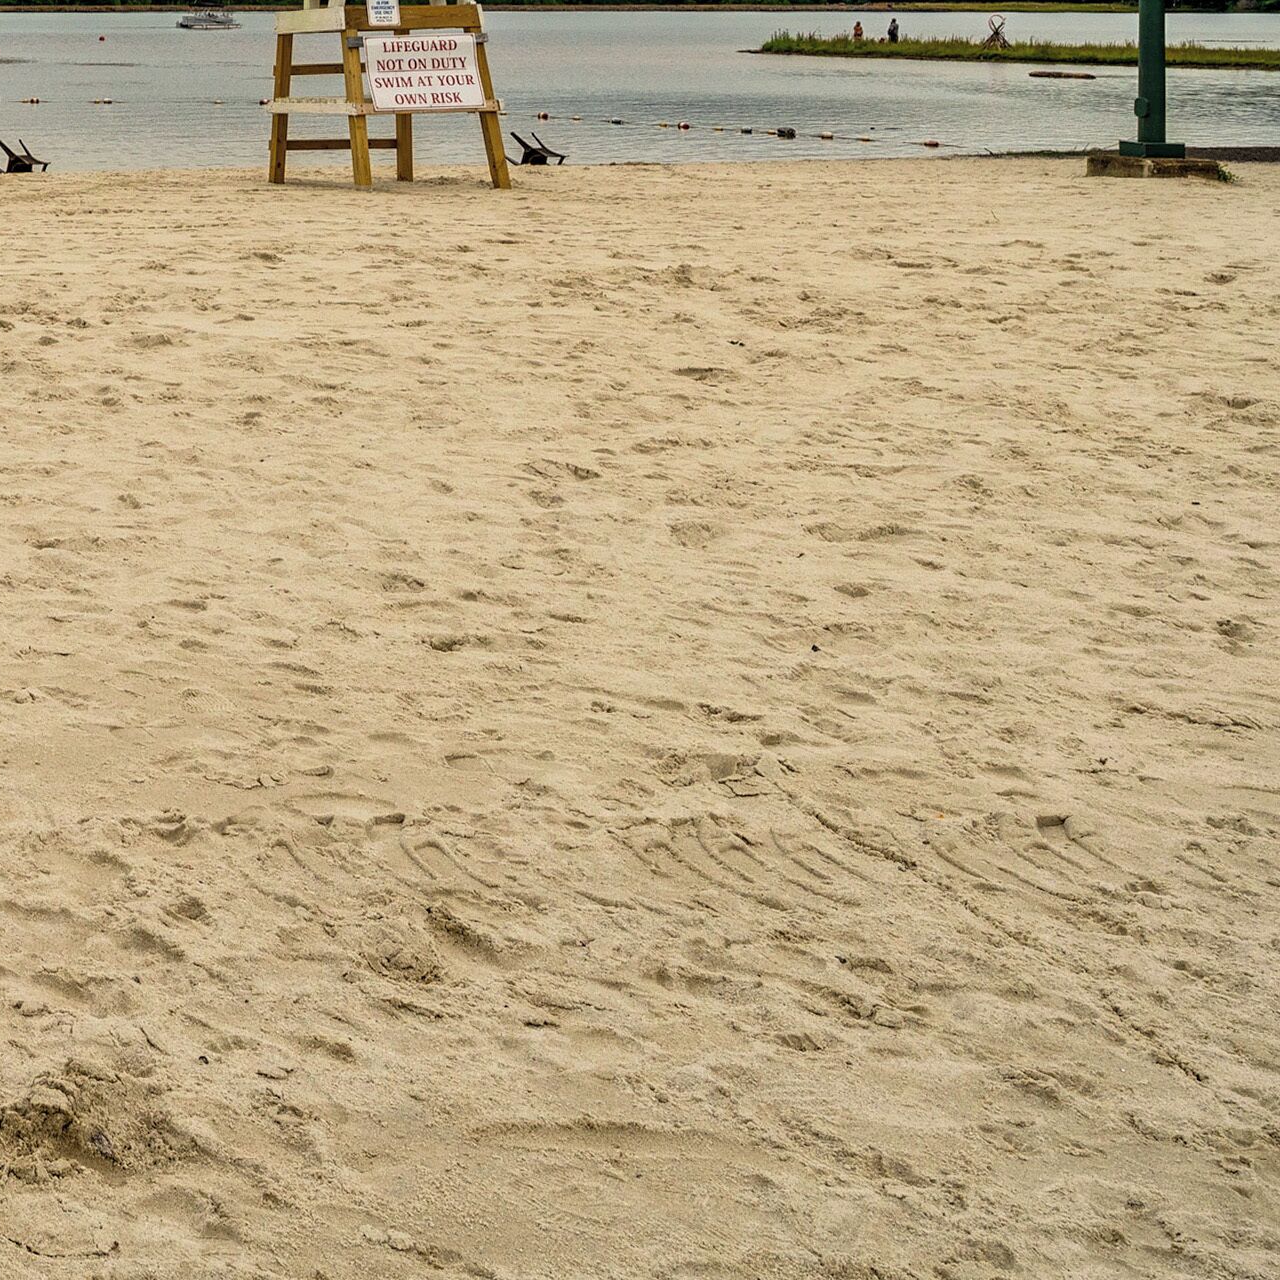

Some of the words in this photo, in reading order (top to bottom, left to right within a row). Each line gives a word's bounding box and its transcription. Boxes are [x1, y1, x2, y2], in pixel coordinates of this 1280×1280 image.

[383, 39, 458, 53] LIFEGUARD
[377, 59, 404, 71] NOT
[408, 58, 427, 70] ON
[432, 57, 467, 69] DUTY
[374, 76, 413, 88] SWIM
[418, 75, 433, 87] AT
[438, 74, 475, 86] YOUR
[395, 93, 427, 105] OWN
[431, 92, 462, 104] RISK
